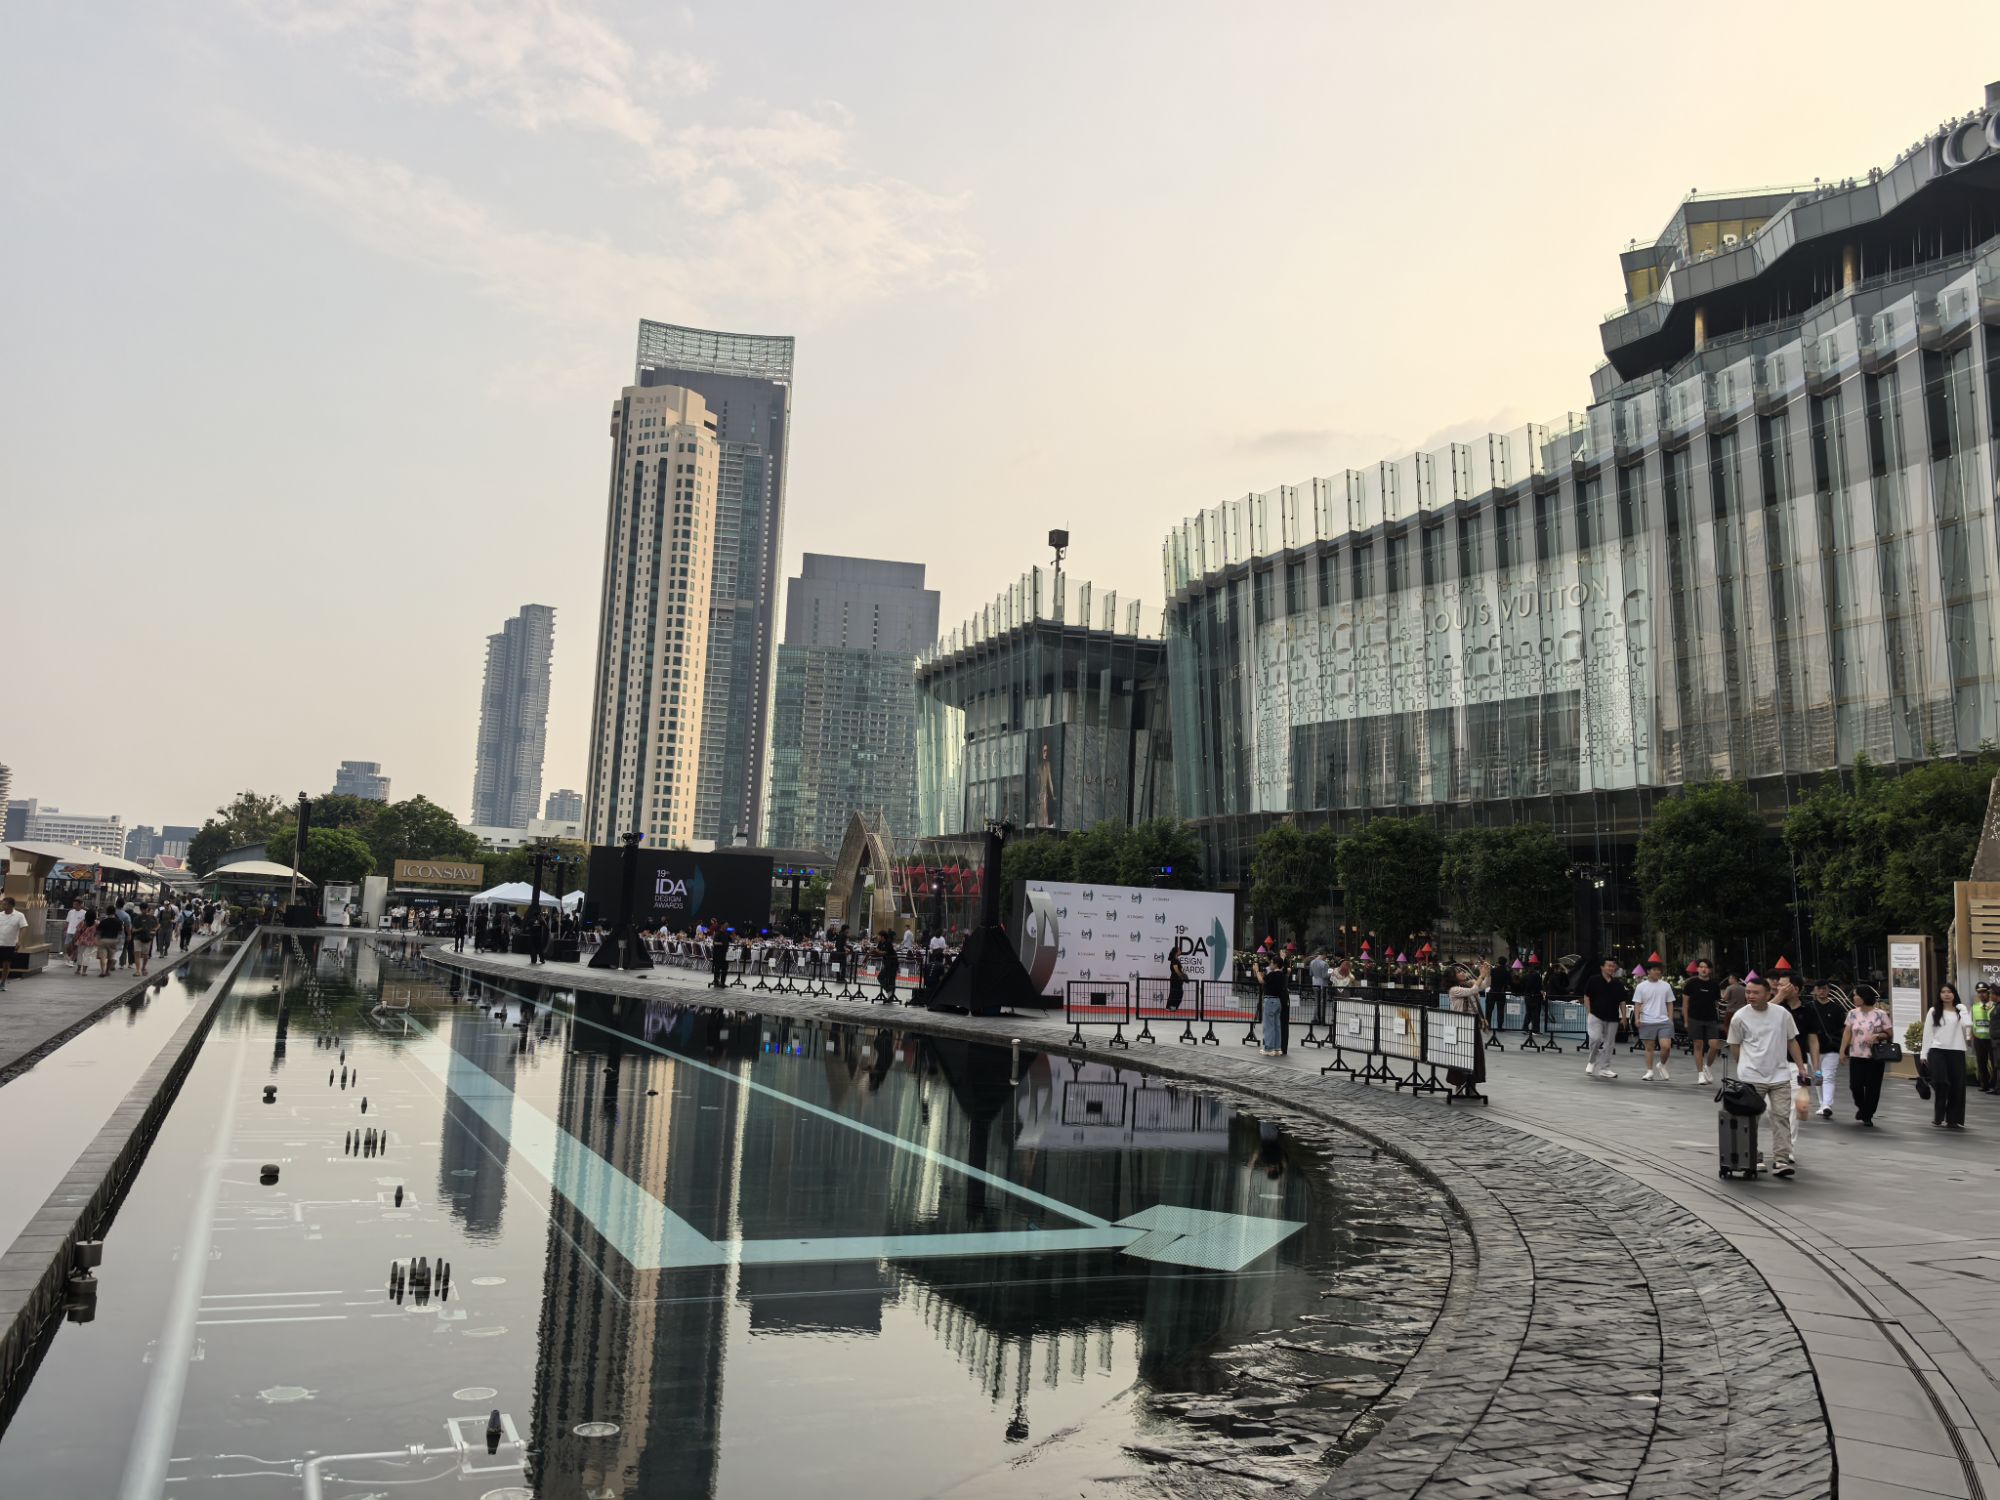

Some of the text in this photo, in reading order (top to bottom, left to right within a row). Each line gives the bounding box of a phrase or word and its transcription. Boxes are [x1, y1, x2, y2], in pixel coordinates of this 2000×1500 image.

[1425, 576, 1610, 635] LOUIS VUITTON
[402, 864, 477, 880] ICONSIAM
[655, 878, 688, 896] IDA
[1174, 936, 1209, 957] IDA
[1180, 957, 1203, 966] ESIGN
[1982, 965, 2000, 973] PRO
